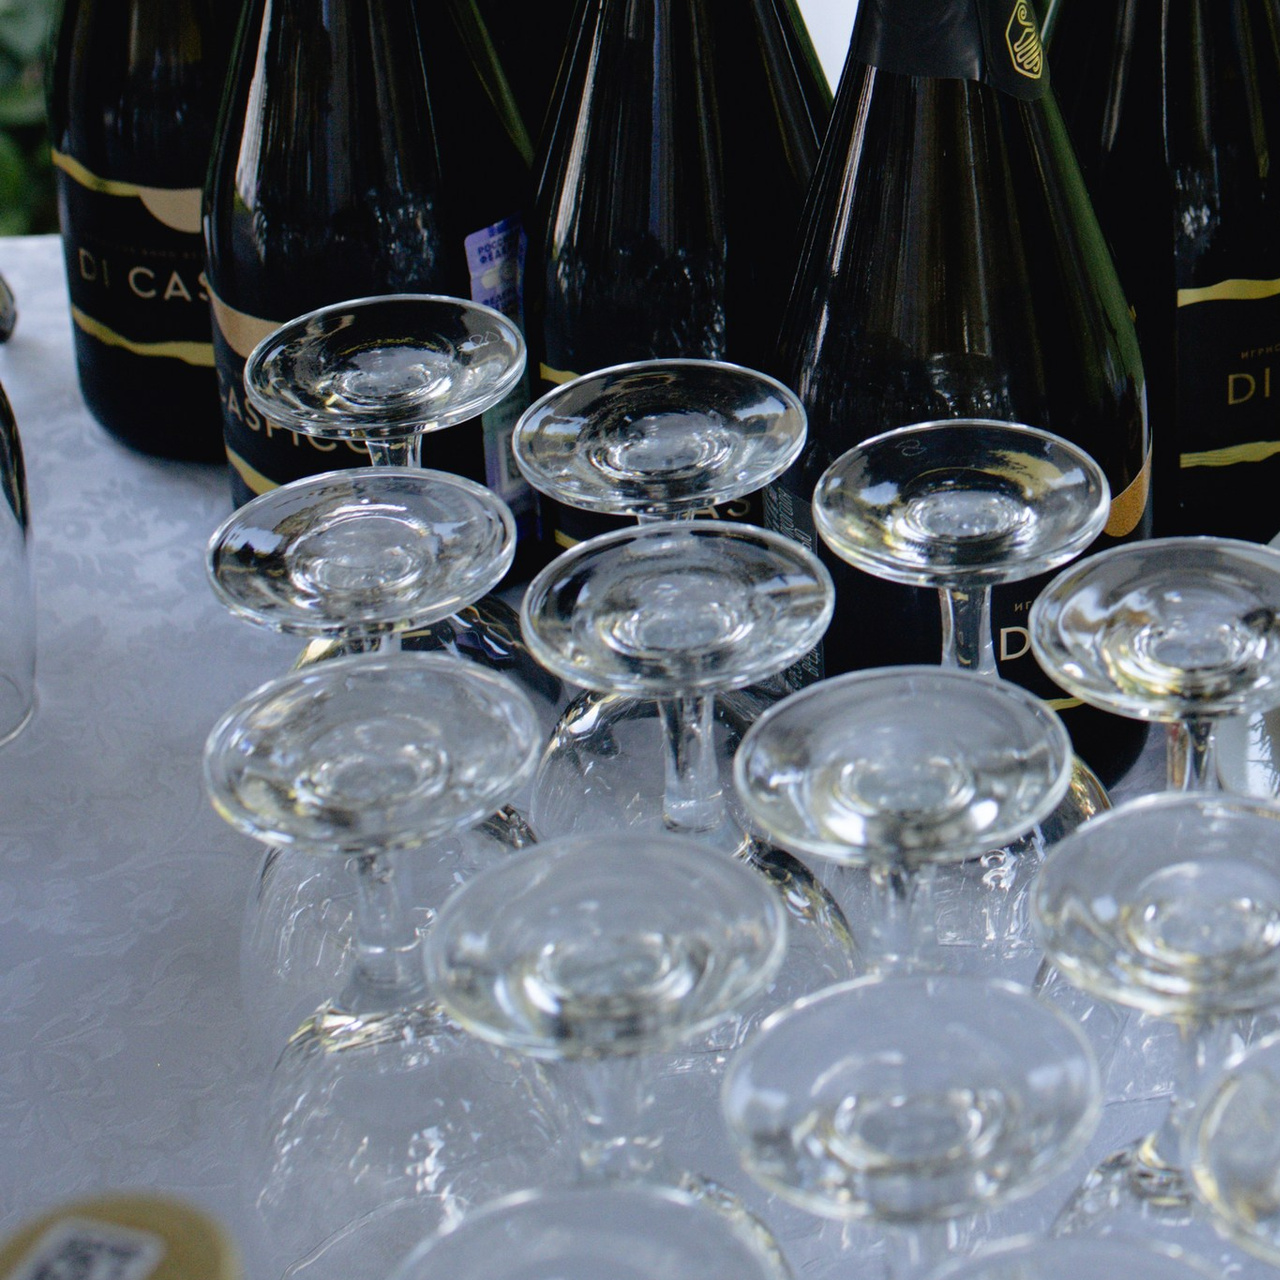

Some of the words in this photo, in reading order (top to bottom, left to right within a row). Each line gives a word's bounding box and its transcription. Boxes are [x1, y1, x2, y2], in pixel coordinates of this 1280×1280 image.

[127, 265, 211, 303] CAS
[1227, 366, 1271, 406] DI
[1000, 625, 1032, 661] D
